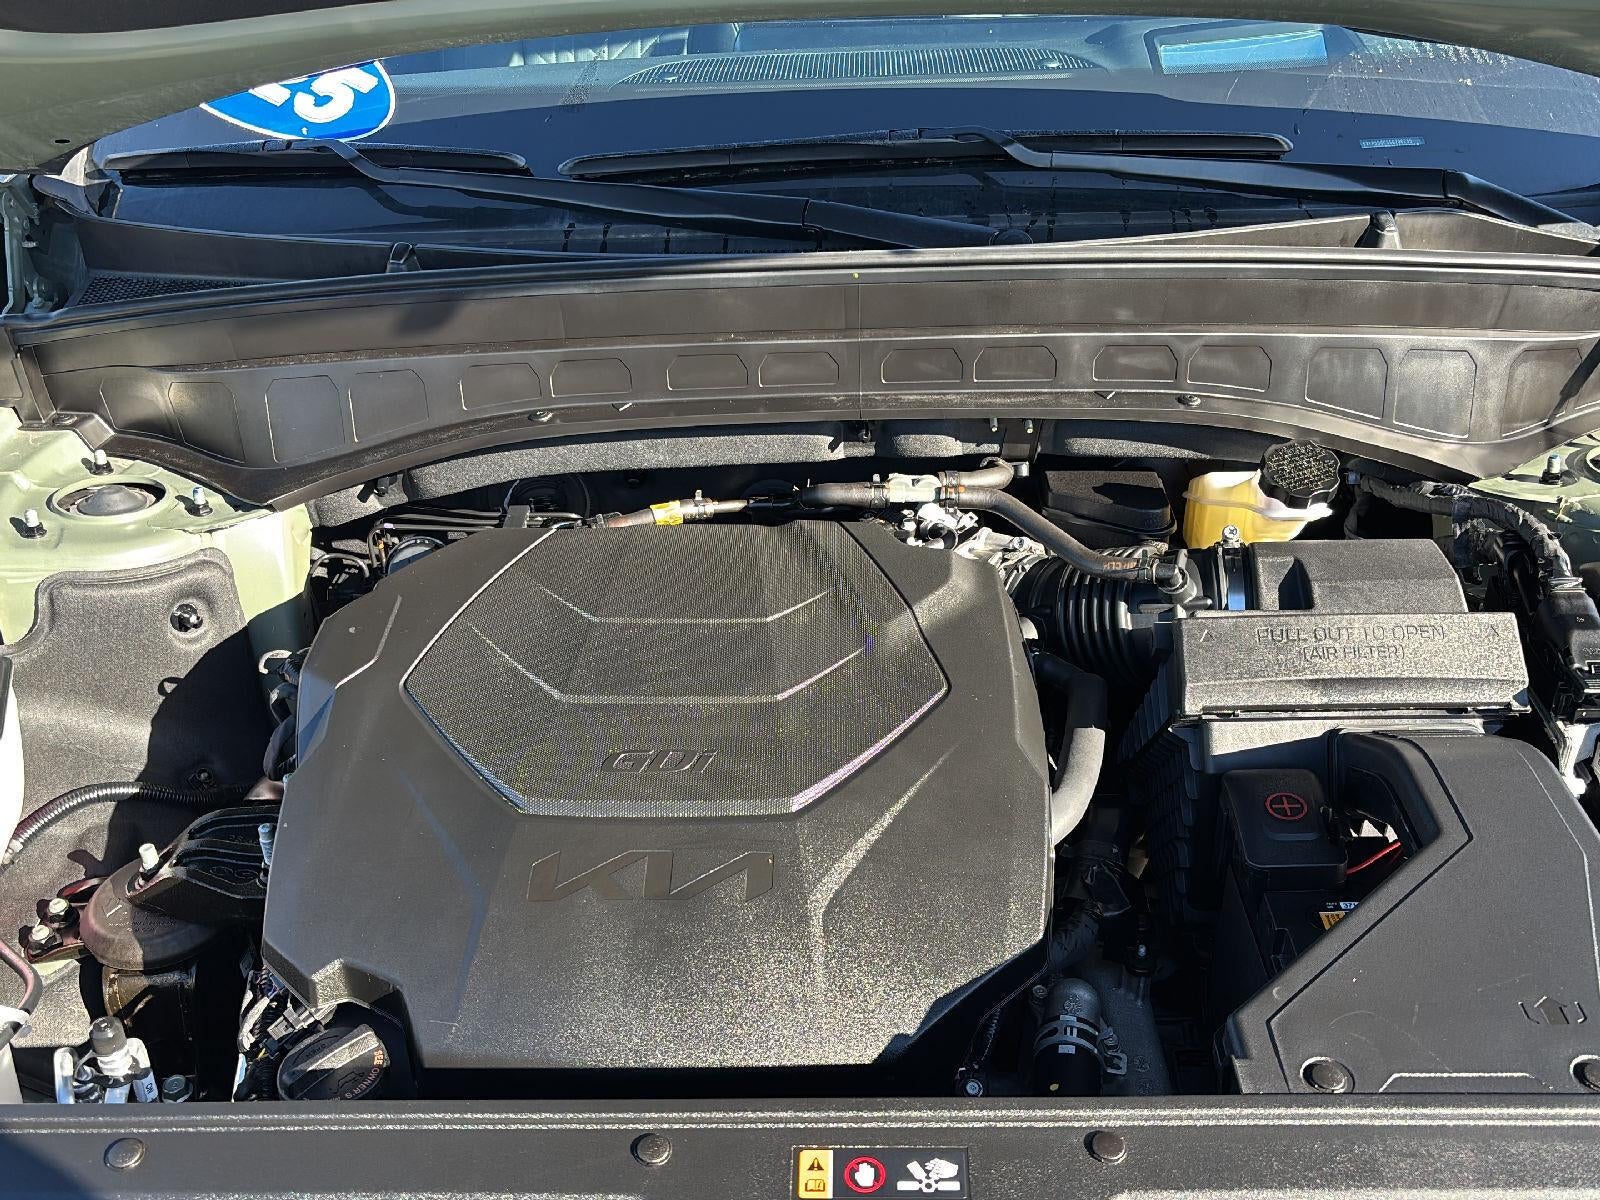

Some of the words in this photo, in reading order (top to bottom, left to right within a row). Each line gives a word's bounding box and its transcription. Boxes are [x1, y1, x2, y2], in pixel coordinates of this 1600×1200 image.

[1256, 627, 1308, 644] PULL
[1313, 626, 1356, 643] OUT
[1359, 625, 1385, 641] TO
[1392, 625, 1446, 640] OPEN
[1302, 646, 1339, 662] (AIR
[1343, 645, 1406, 660] FILTER)
[527, 850, 774, 901] KIA
[373, 1050, 384, 1066] SEE
[344, 1067, 380, 1099] OWNER'S
